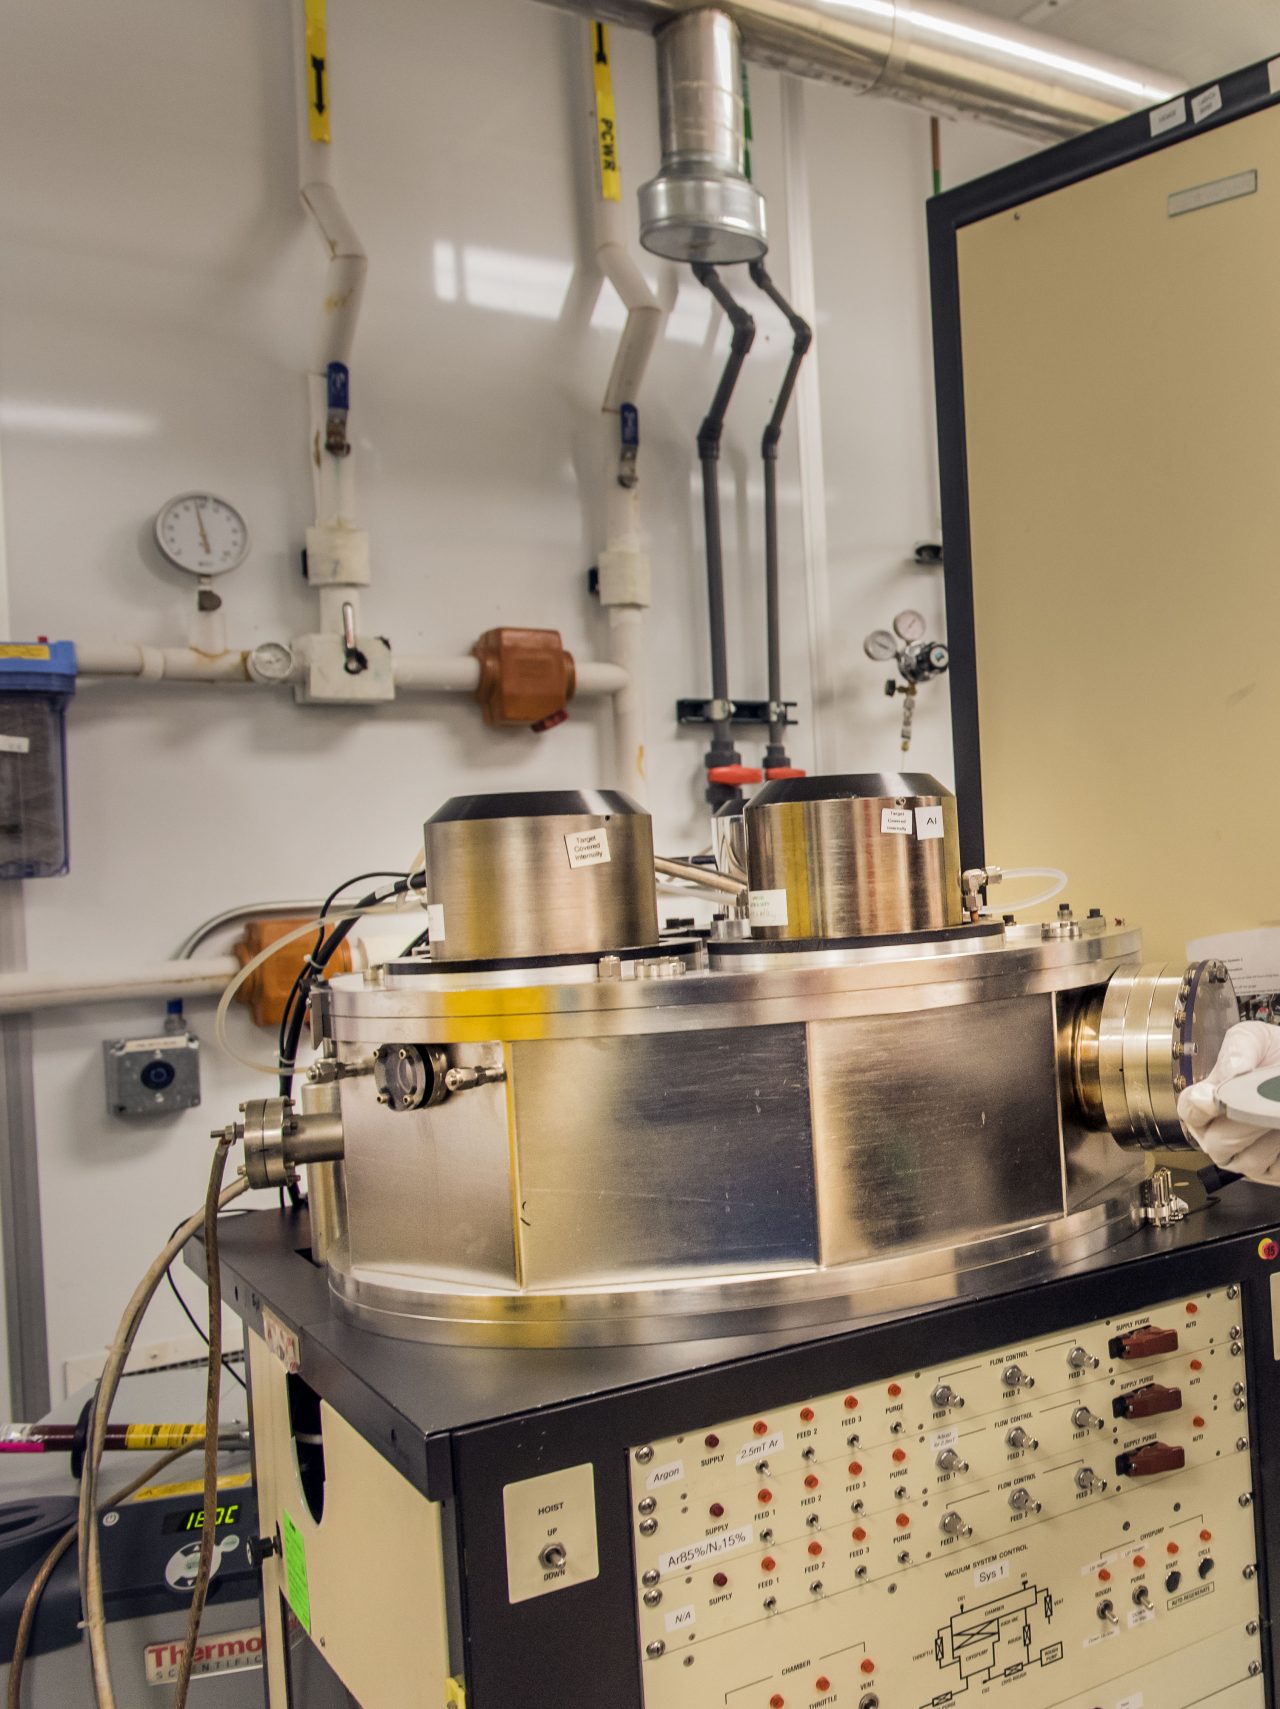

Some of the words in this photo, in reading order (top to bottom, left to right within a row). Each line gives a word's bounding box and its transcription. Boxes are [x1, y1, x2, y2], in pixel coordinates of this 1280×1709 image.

[601, 117, 616, 172] PCWR
[926, 817, 937, 825] Al
[990, 1357, 1004, 1367] FLOW
[1005, 1351, 1029, 1362] CONTROL
[1002, 1390, 1016, 1399] FEED
[885, 1403, 904, 1414] PURGE
[932, 1409, 947, 1420] FEED
[841, 1417, 856, 1427] FEED
[857, 1415, 862, 1423] 3
[994, 1419, 1009, 1429] FLOW
[1010, 1412, 1033, 1424] CONTROL
[796, 1429, 812, 1440] FEED
[813, 1427, 818, 1436] 2
[740, 1445, 767, 1459] 2.5mT
[768, 1438, 779, 1449] Ar
[700, 1454, 725, 1467] SUPPLY
[1007, 1452, 1020, 1461] FEED
[653, 1466, 680, 1483] Argon
[889, 1467, 909, 1479] PURGE
[937, 1473, 951, 1483] FEED
[845, 1482, 861, 1493] FEED
[997, 1480, 1012, 1491] FLOW
[1013, 1473, 1036, 1485] CONTROL
[800, 1496, 816, 1507] FEED
[817, 1494, 822, 1503] 2
[538, 1502, 564, 1515] HOIST
[754, 1511, 770, 1521] FEED
[1010, 1513, 1024, 1523] FEED
[547, 1527, 558, 1537] UP
[705, 1523, 729, 1536] SUPPLY
[892, 1533, 911, 1545] PURGE
[940, 1537, 954, 1547] FEED
[849, 1549, 864, 1559] FEED
[865, 1546, 870, 1555] 3
[804, 1563, 819, 1574] FEED
[820, 1561, 825, 1569] 2
[944, 1564, 971, 1578] VACUUM
[972, 1554, 998, 1569] SYSTEM
[999, 1544, 1029, 1560] CONTROL
[543, 1569, 566, 1581] DOWN
[979, 1570, 997, 1583] Sys
[999, 1566, 1004, 1575] 1
[757, 1579, 773, 1590] FEED
[708, 1592, 733, 1606] SUPPLY
[675, 1611, 691, 1624] N/A
[148, 1637, 263, 1668] Thermo
[155, 1654, 263, 1680] SCNTIFIC
[781, 1659, 811, 1676] CHAMBER
[860, 1679, 875, 1691] VENT
[808, 1694, 838, 1709] THROTTLE
